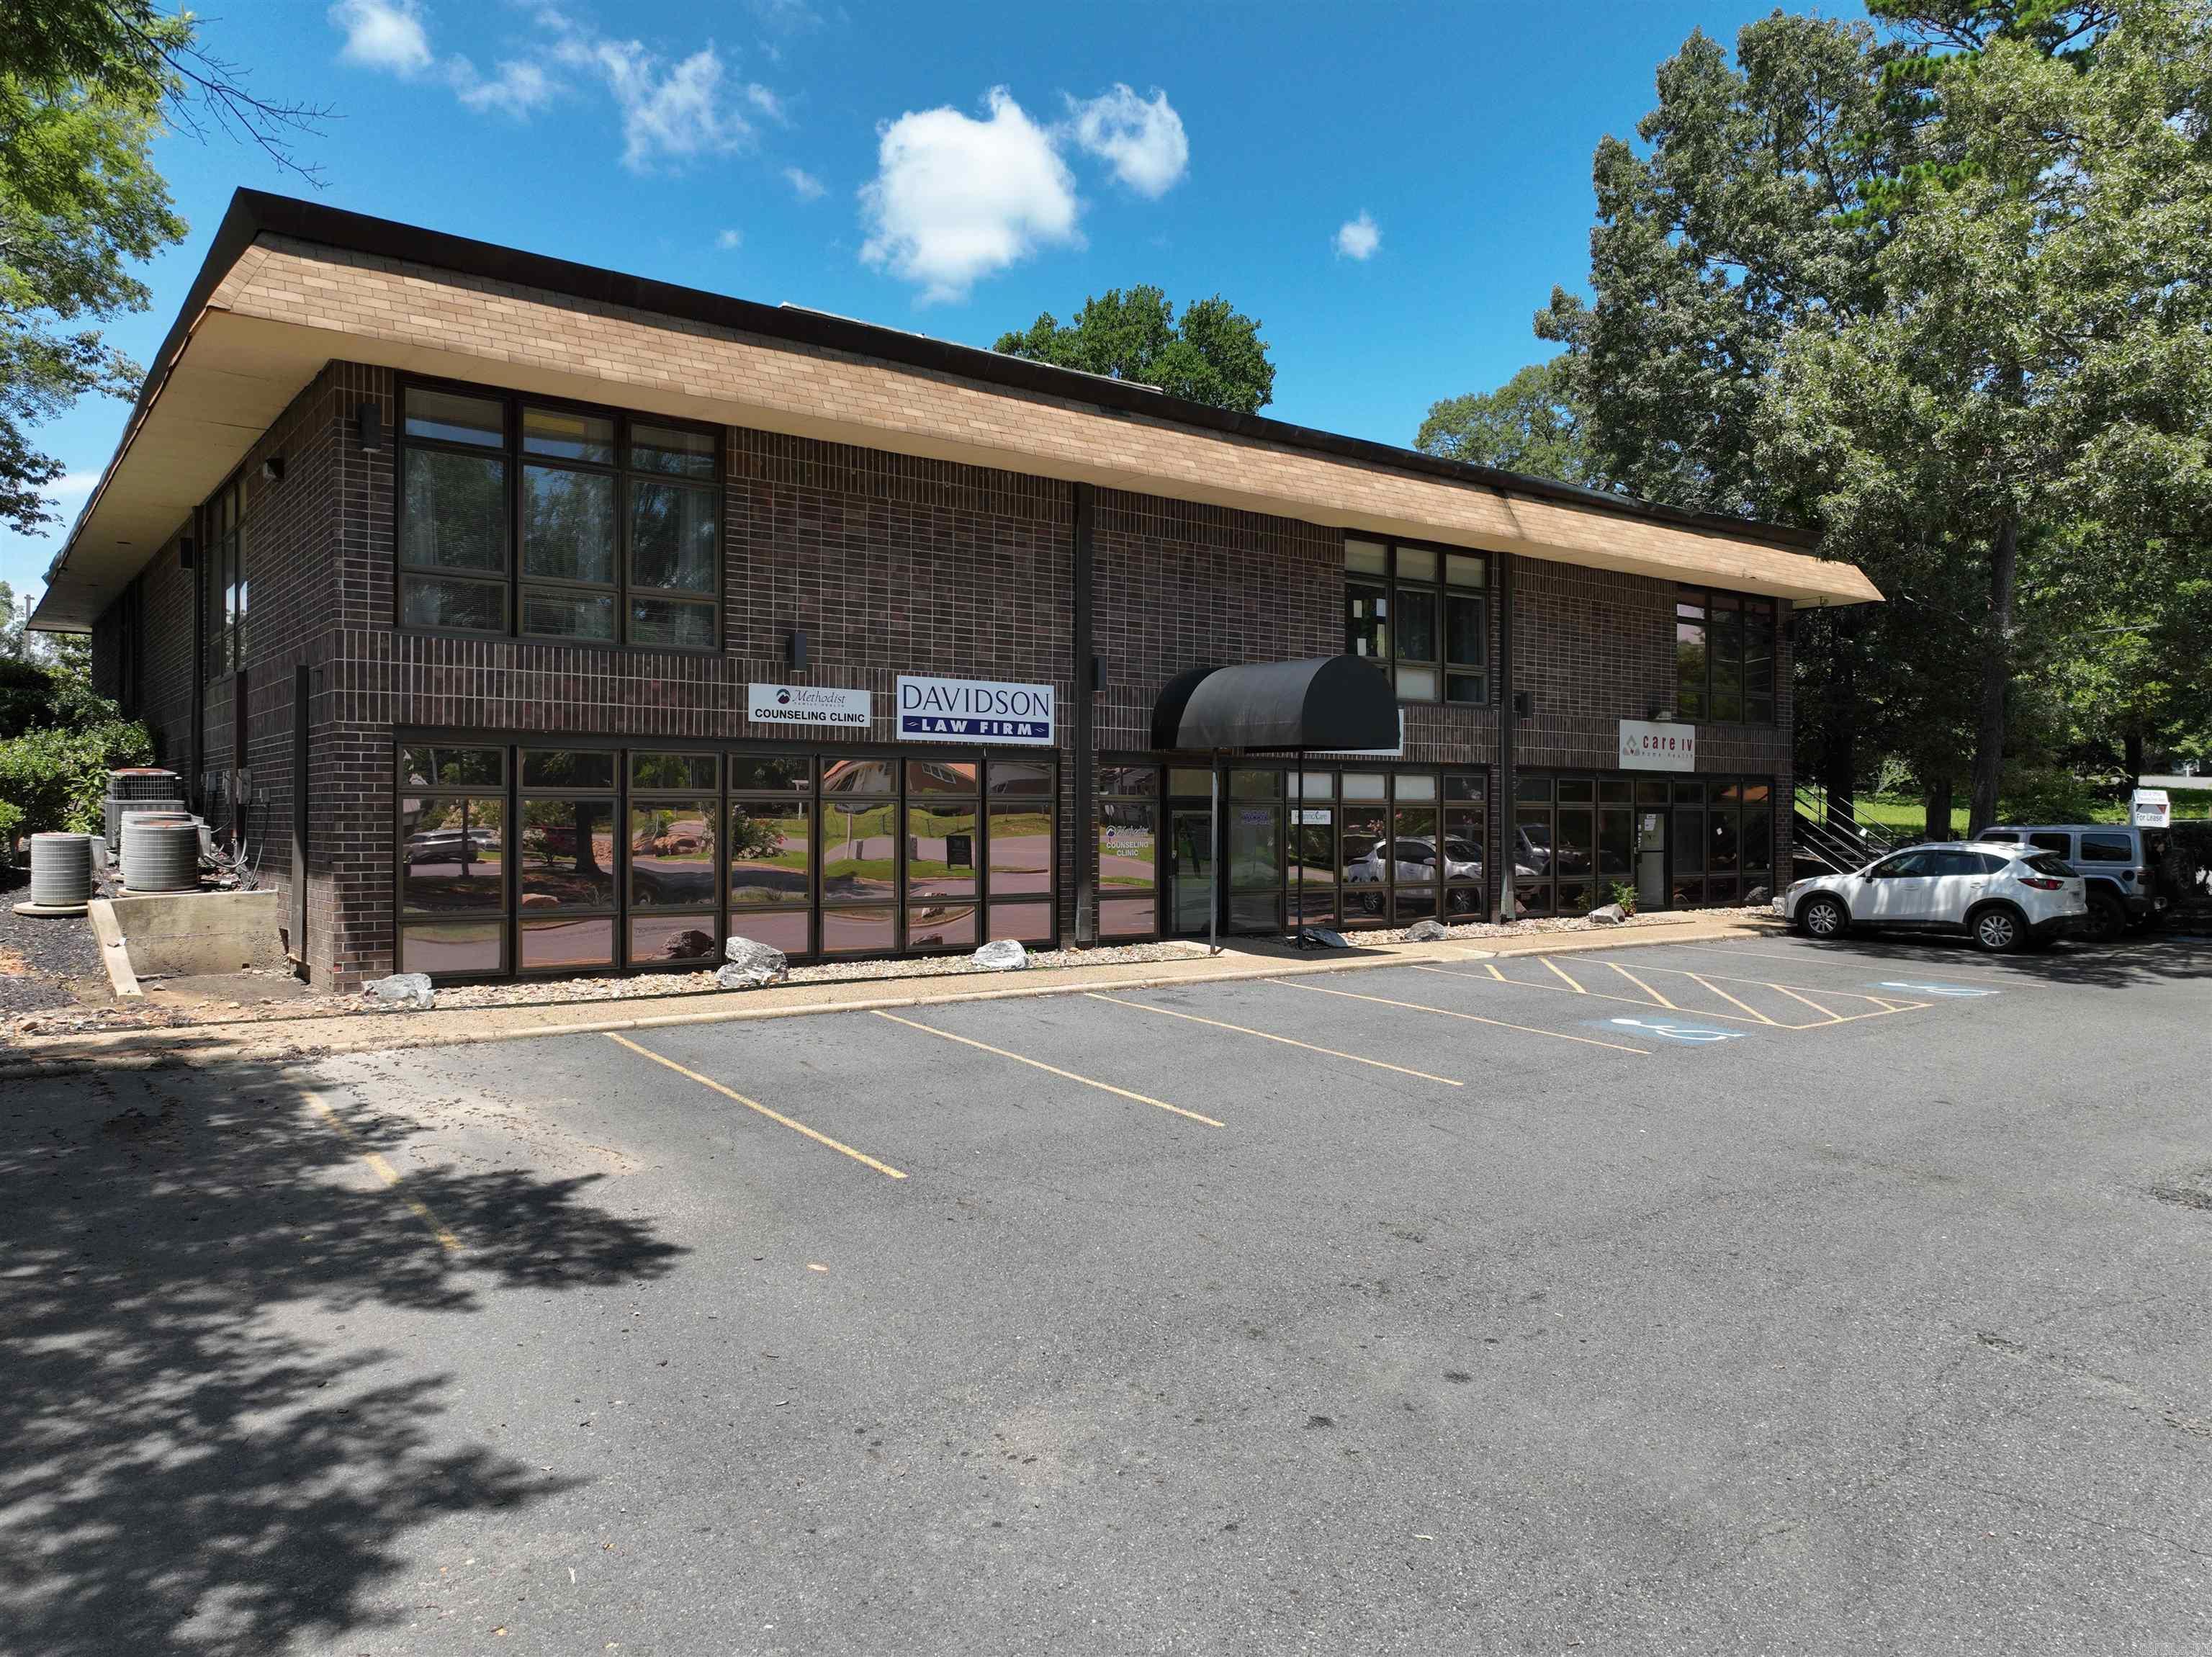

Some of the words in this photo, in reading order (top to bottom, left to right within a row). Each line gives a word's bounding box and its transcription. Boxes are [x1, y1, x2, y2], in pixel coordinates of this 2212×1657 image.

[792, 689, 846, 704] Methodist
[902, 684, 1050, 717] DAVIDSON
[755, 708, 827, 721] COUNSELING
[830, 712, 865, 722] CLINIC
[922, 719, 968, 733] LAW
[979, 722, 1032, 735] FIRM
[1642, 735, 1676, 750] care
